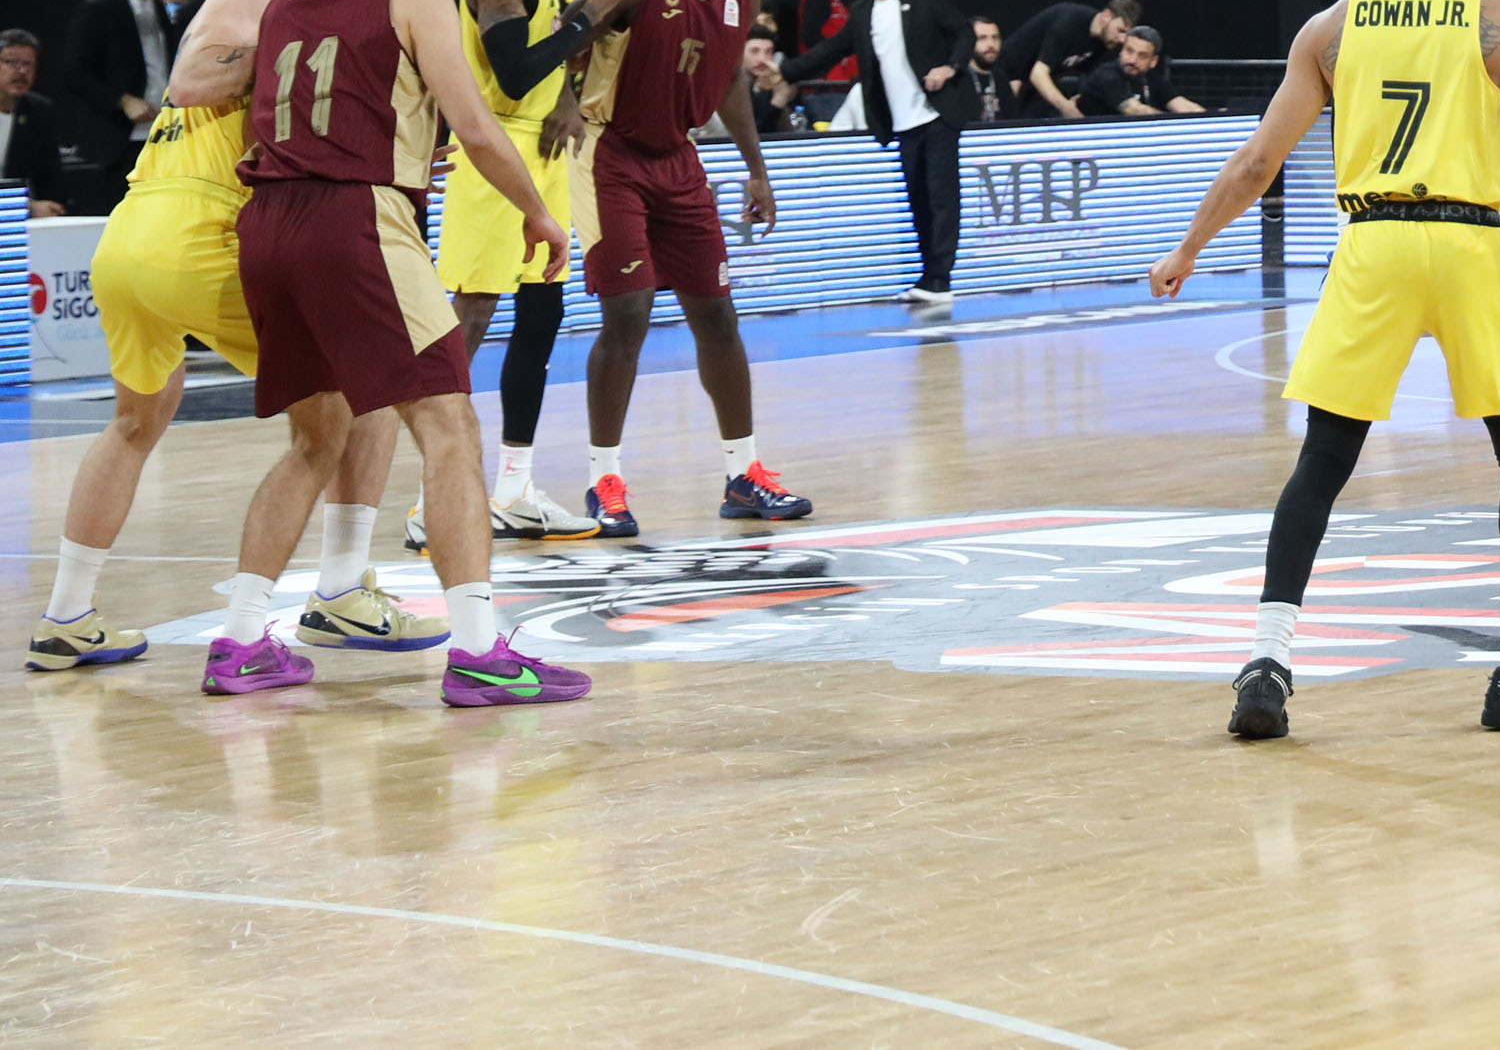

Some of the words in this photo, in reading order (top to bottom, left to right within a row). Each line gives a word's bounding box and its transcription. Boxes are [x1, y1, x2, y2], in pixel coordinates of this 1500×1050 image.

[1354, 0, 1432, 28] COWAN
[1436, 1, 1470, 28] JR.
[274, 35, 339, 142] 11
[1381, 80, 1431, 175] 7
